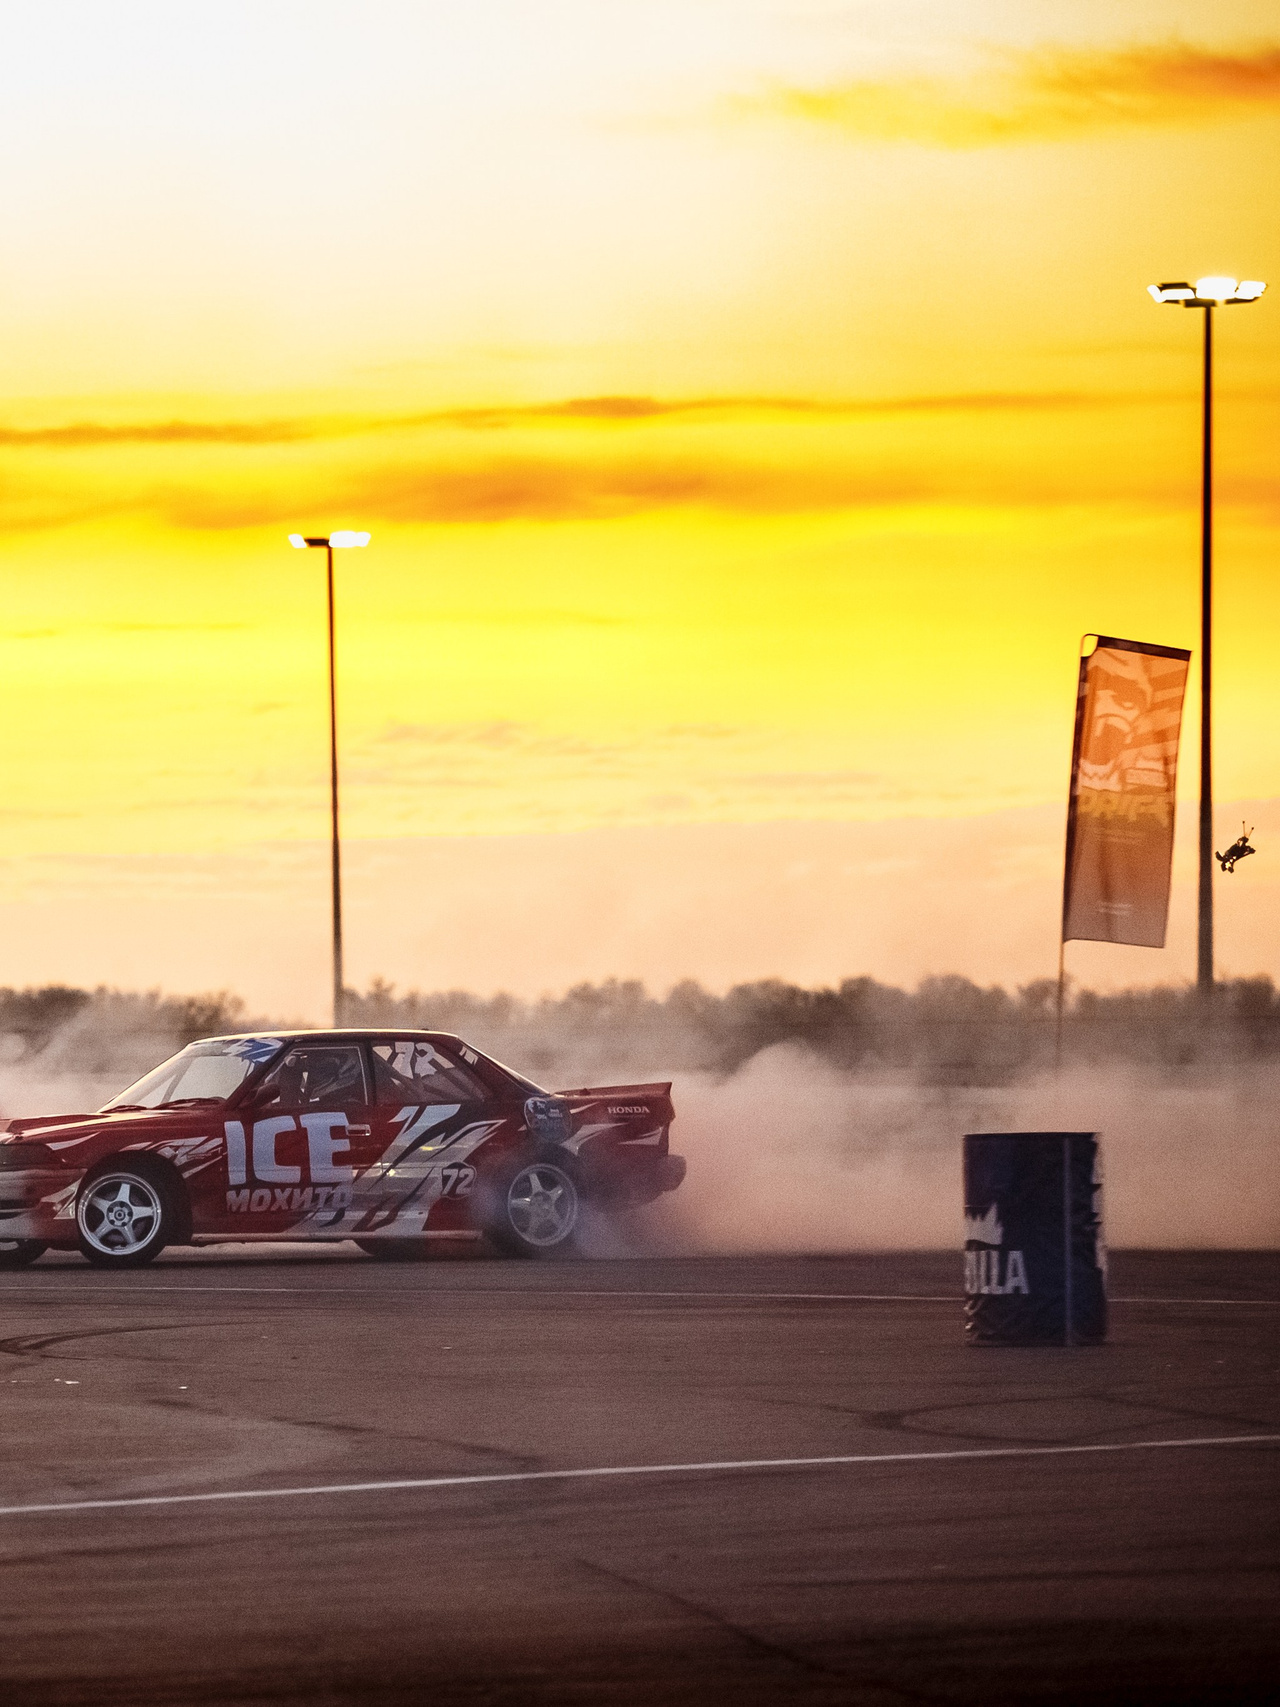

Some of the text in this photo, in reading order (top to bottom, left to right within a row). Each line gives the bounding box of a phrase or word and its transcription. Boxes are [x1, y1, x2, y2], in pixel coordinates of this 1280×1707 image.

[607, 1106, 650, 1114] HONDA
[224, 1111, 354, 1186] ICE
[441, 1168, 475, 1195] 72
[226, 1186, 353, 1213] МОХИТО
